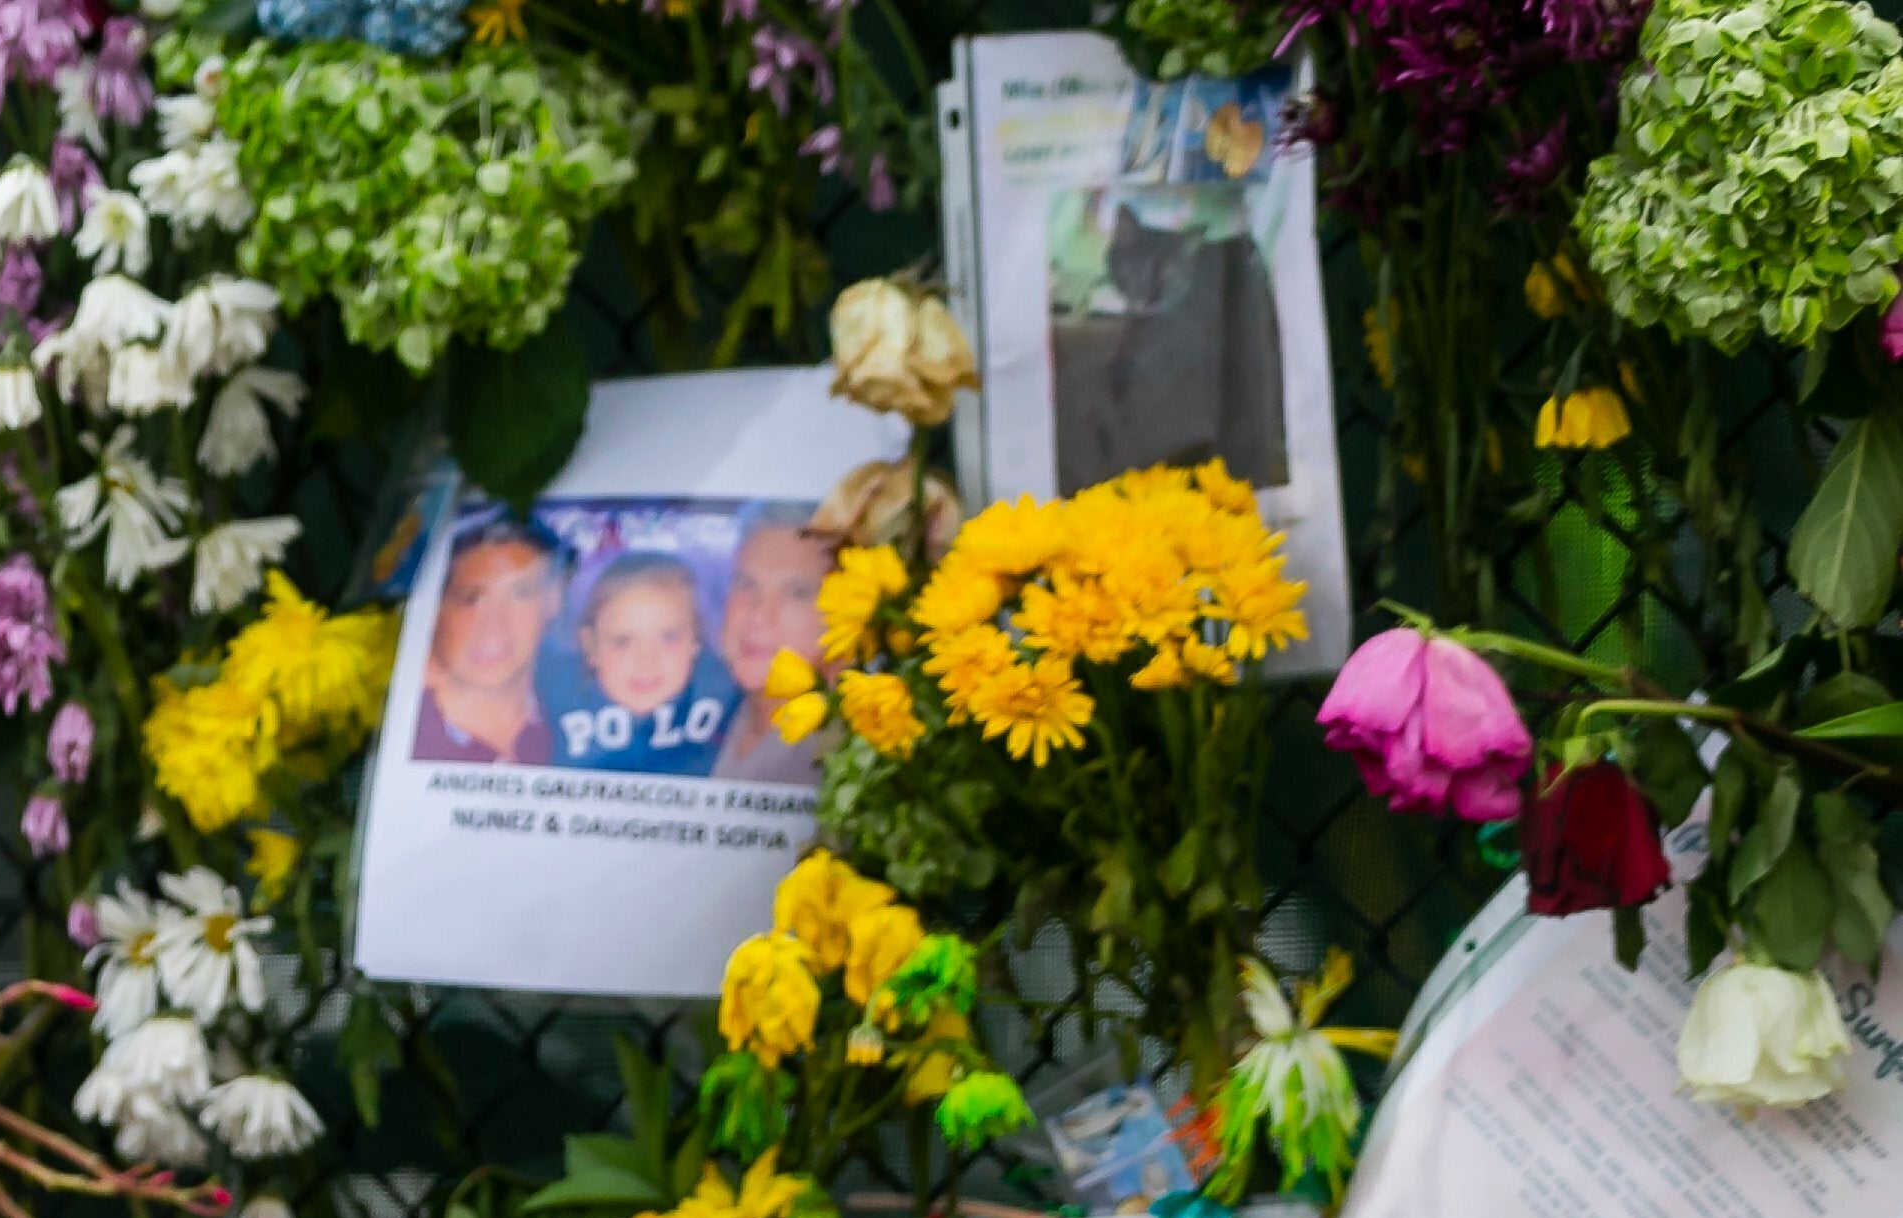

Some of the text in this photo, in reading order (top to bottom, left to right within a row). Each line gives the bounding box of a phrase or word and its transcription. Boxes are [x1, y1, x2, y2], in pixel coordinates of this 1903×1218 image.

[426, 771, 525, 797] ANDRES
[545, 810, 560, 834] &
[568, 812, 709, 843] DAUGHTER
[715, 823, 789, 850] SOFIA
